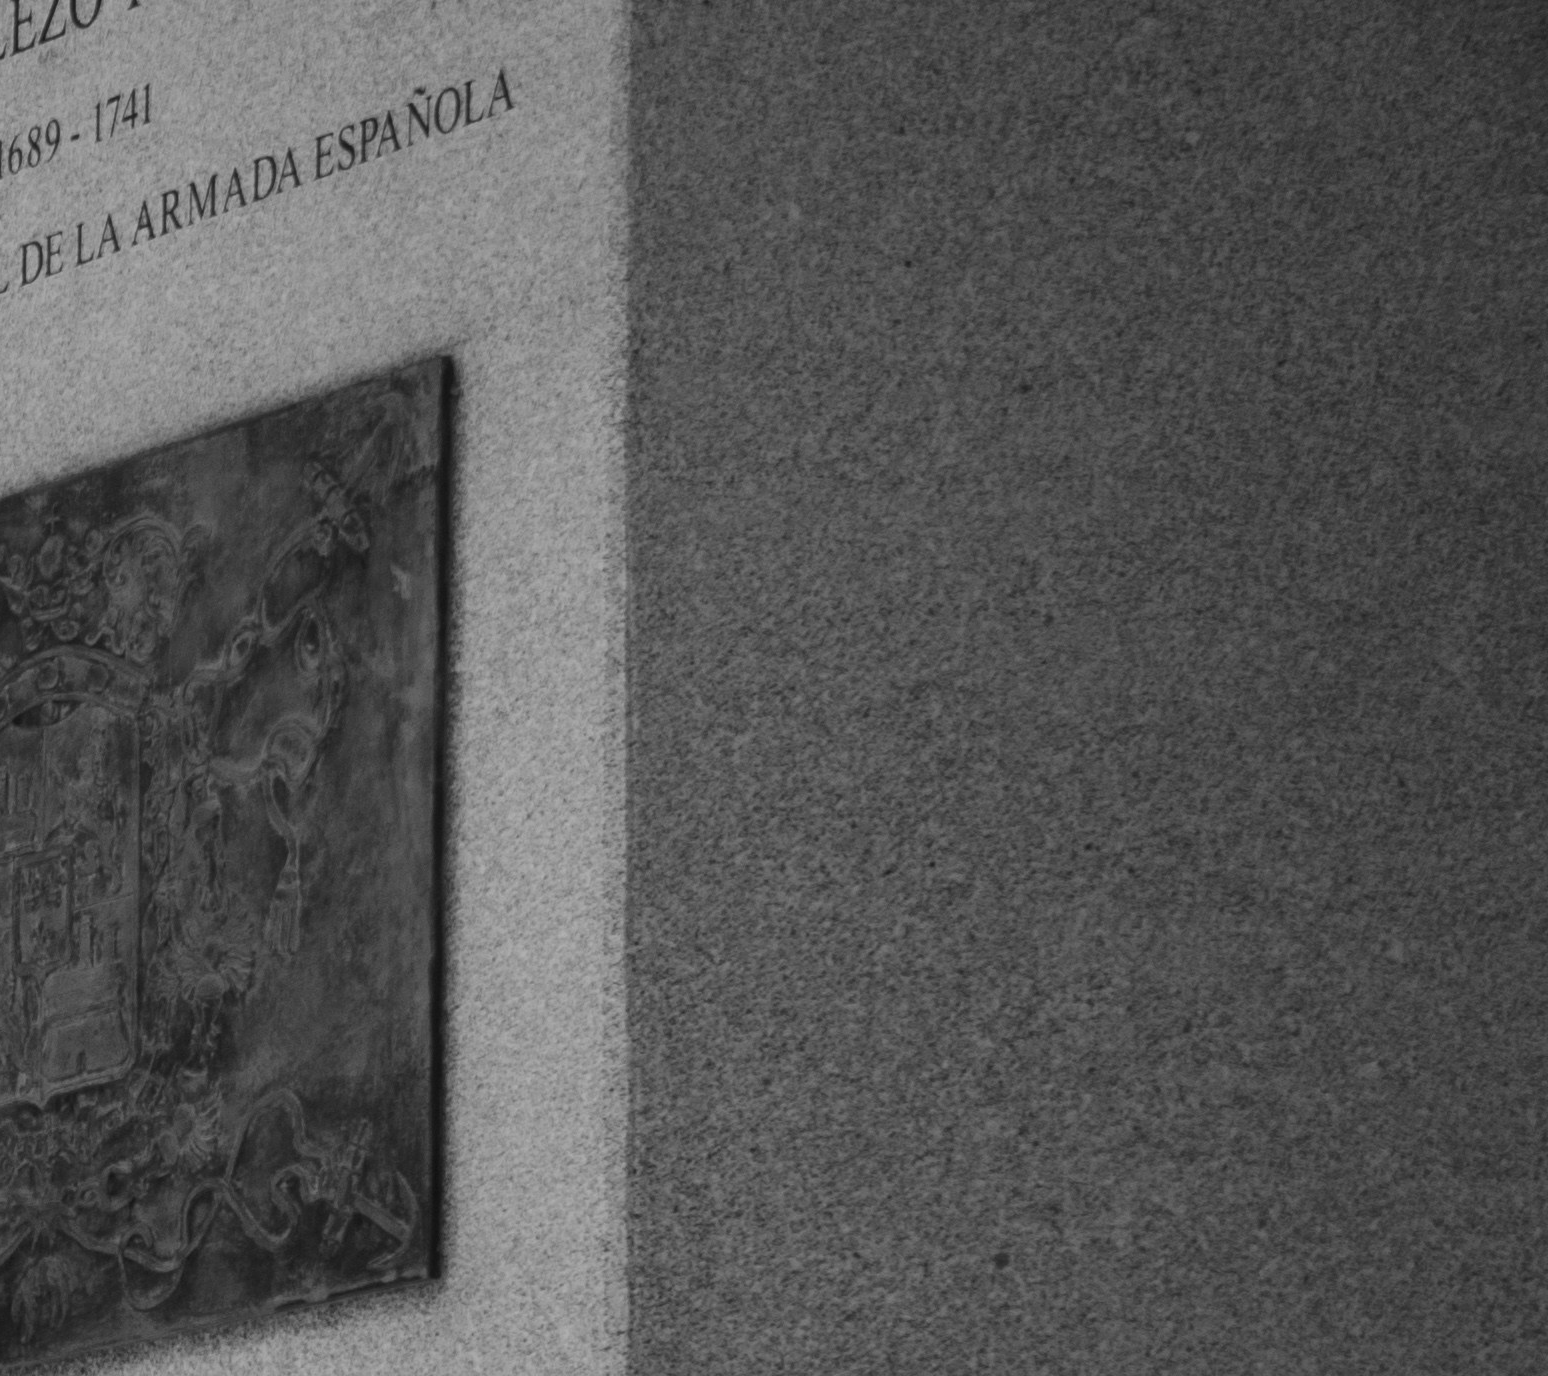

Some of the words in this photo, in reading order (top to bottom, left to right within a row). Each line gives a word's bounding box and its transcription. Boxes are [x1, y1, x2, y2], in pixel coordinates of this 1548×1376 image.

[20, 230, 64, 287] DE
[75, 213, 122, 267] LA
[131, 147, 304, 245] ARMADA
[315, 68, 515, 180] ESPAÑOLA
[94, 83, 151, 143] 1741
